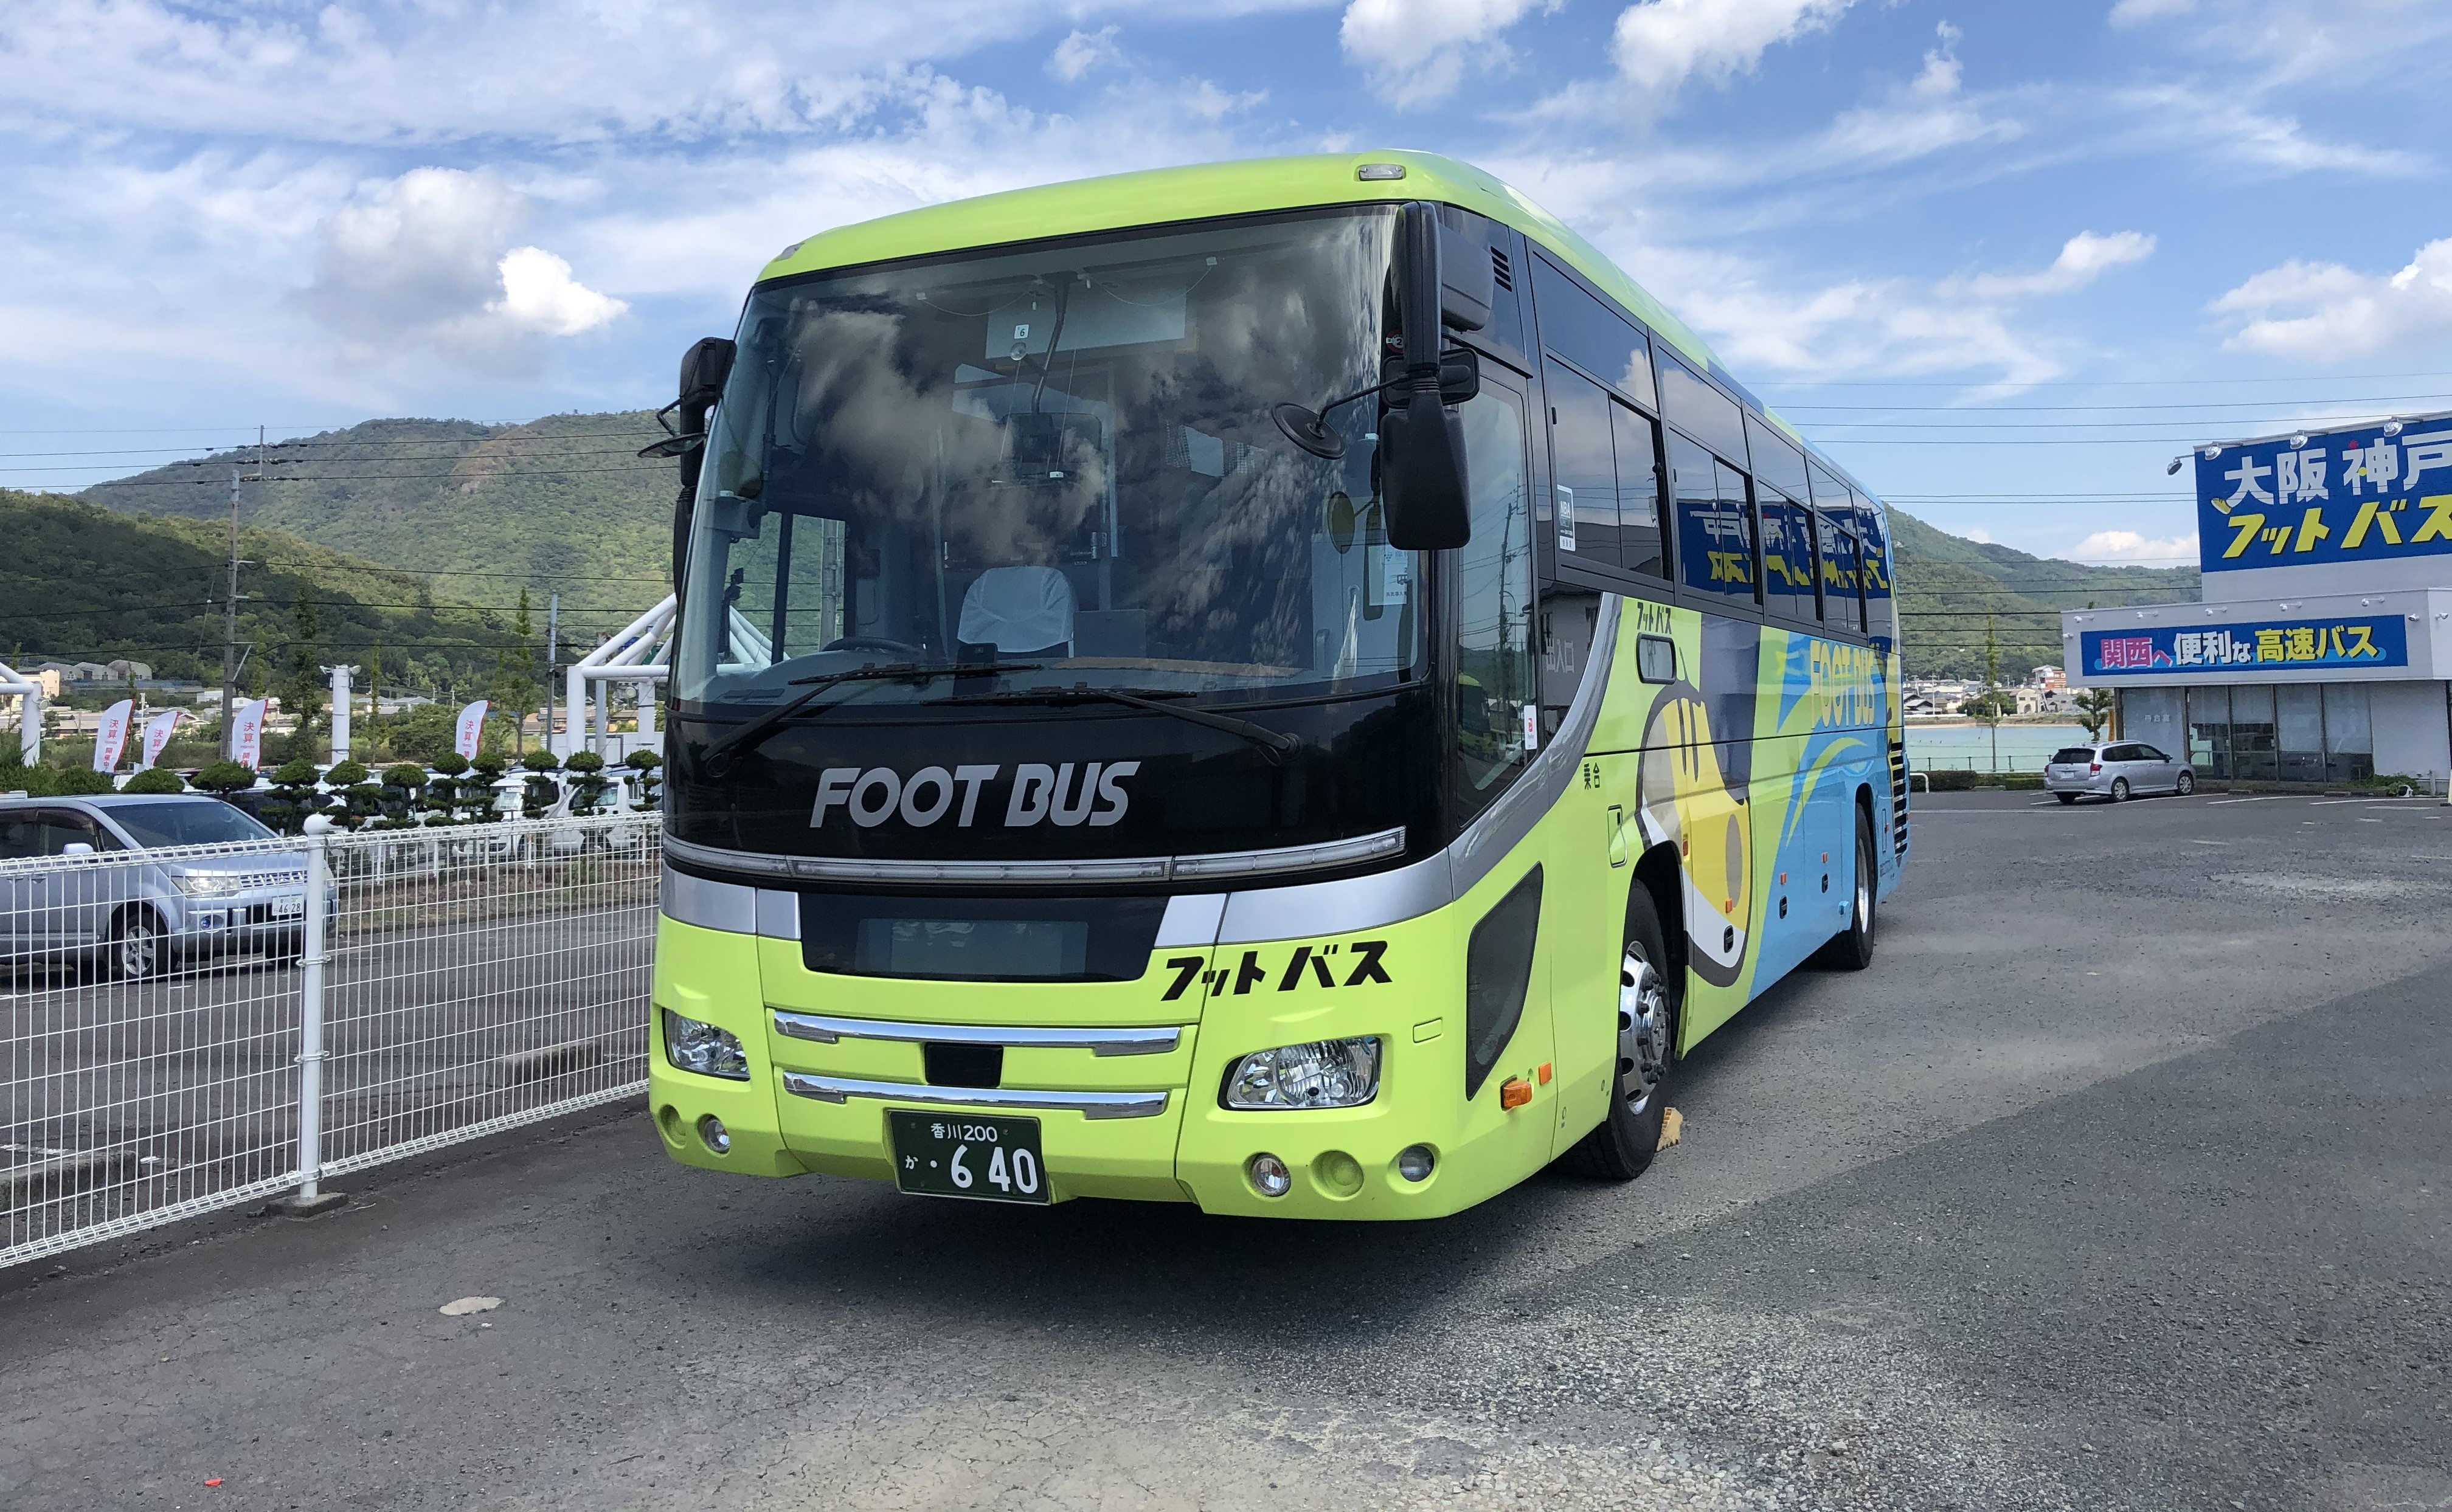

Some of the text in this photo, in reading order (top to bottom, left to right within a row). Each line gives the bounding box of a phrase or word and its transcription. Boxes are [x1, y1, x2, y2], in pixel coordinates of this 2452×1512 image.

[2225, 430, 2452, 505] 大阪 神戸
[2222, 494, 2452, 559] フットバス
[1637, 601, 1672, 635] フットバス
[1810, 639, 1851, 730] FOOT
[243, 722, 254, 743] 決算
[809, 761, 1141, 828] FOOT BUS
[1160, 940, 1393, 1002] フットバス
